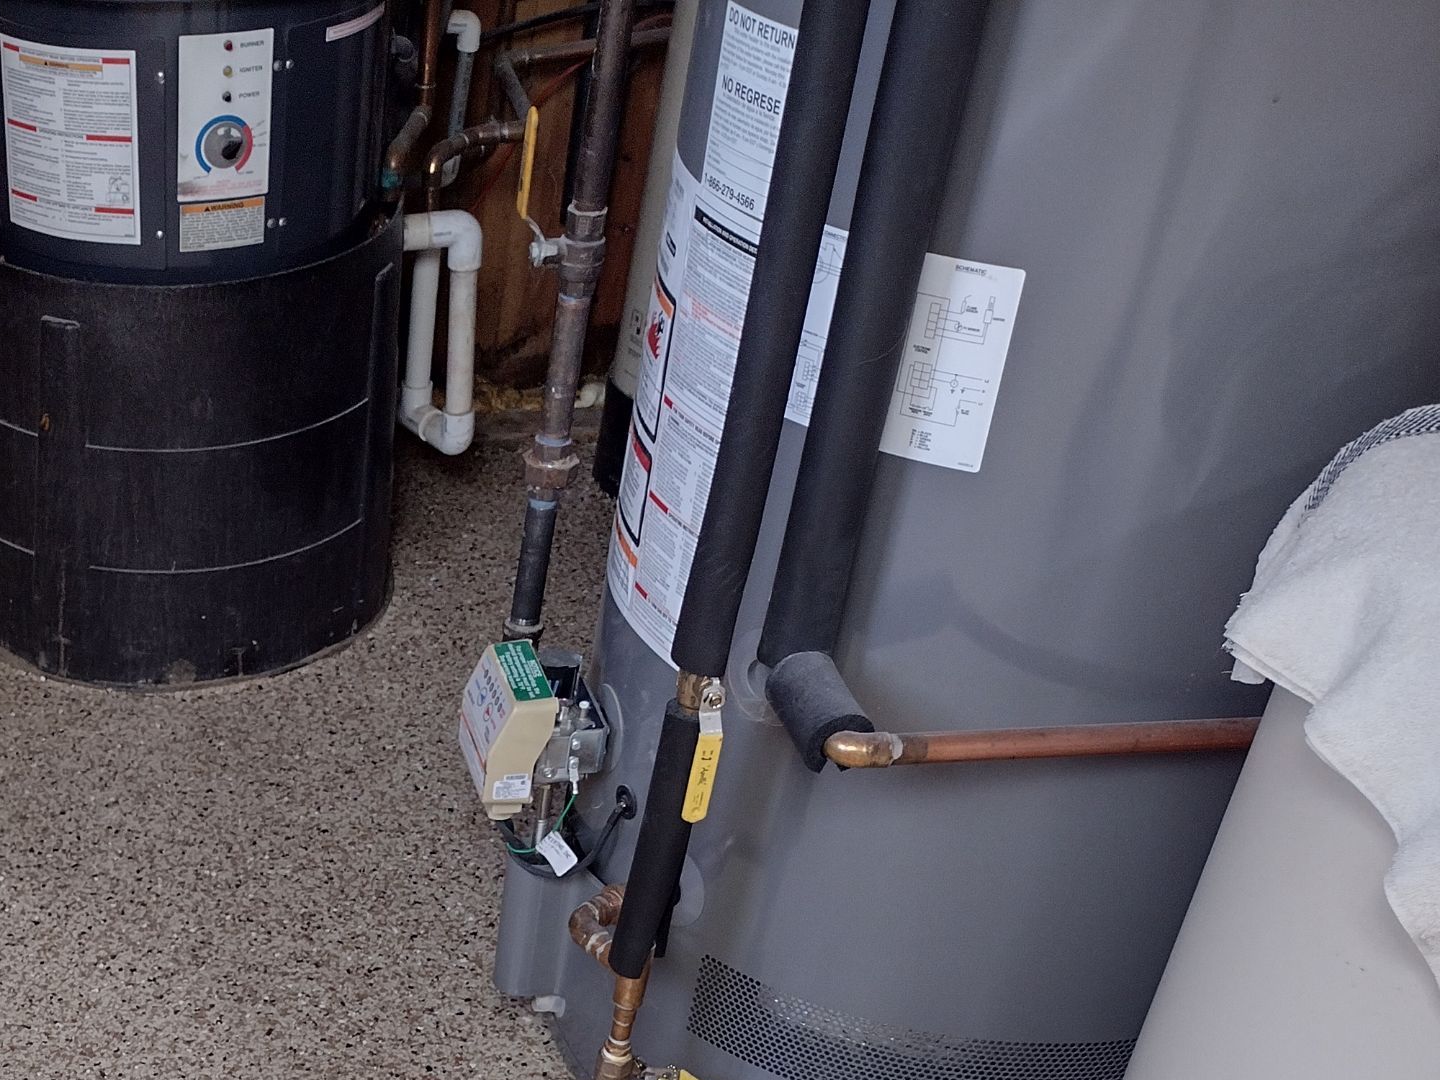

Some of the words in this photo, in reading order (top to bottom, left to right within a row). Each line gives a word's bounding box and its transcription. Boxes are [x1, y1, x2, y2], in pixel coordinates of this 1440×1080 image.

[729, 7, 739, 25] DO
[740, 13, 757, 34] NOT
[757, 22, 796, 49] RETURN
[240, 40, 265, 48] BURNER
[240, 65, 263, 73] IGNITER
[238, 91, 260, 99] POWER
[722, 74, 734, 93] NO
[735, 82, 781, 115] REGRESE
[704, 172, 755, 211] 1-866-279-4566
